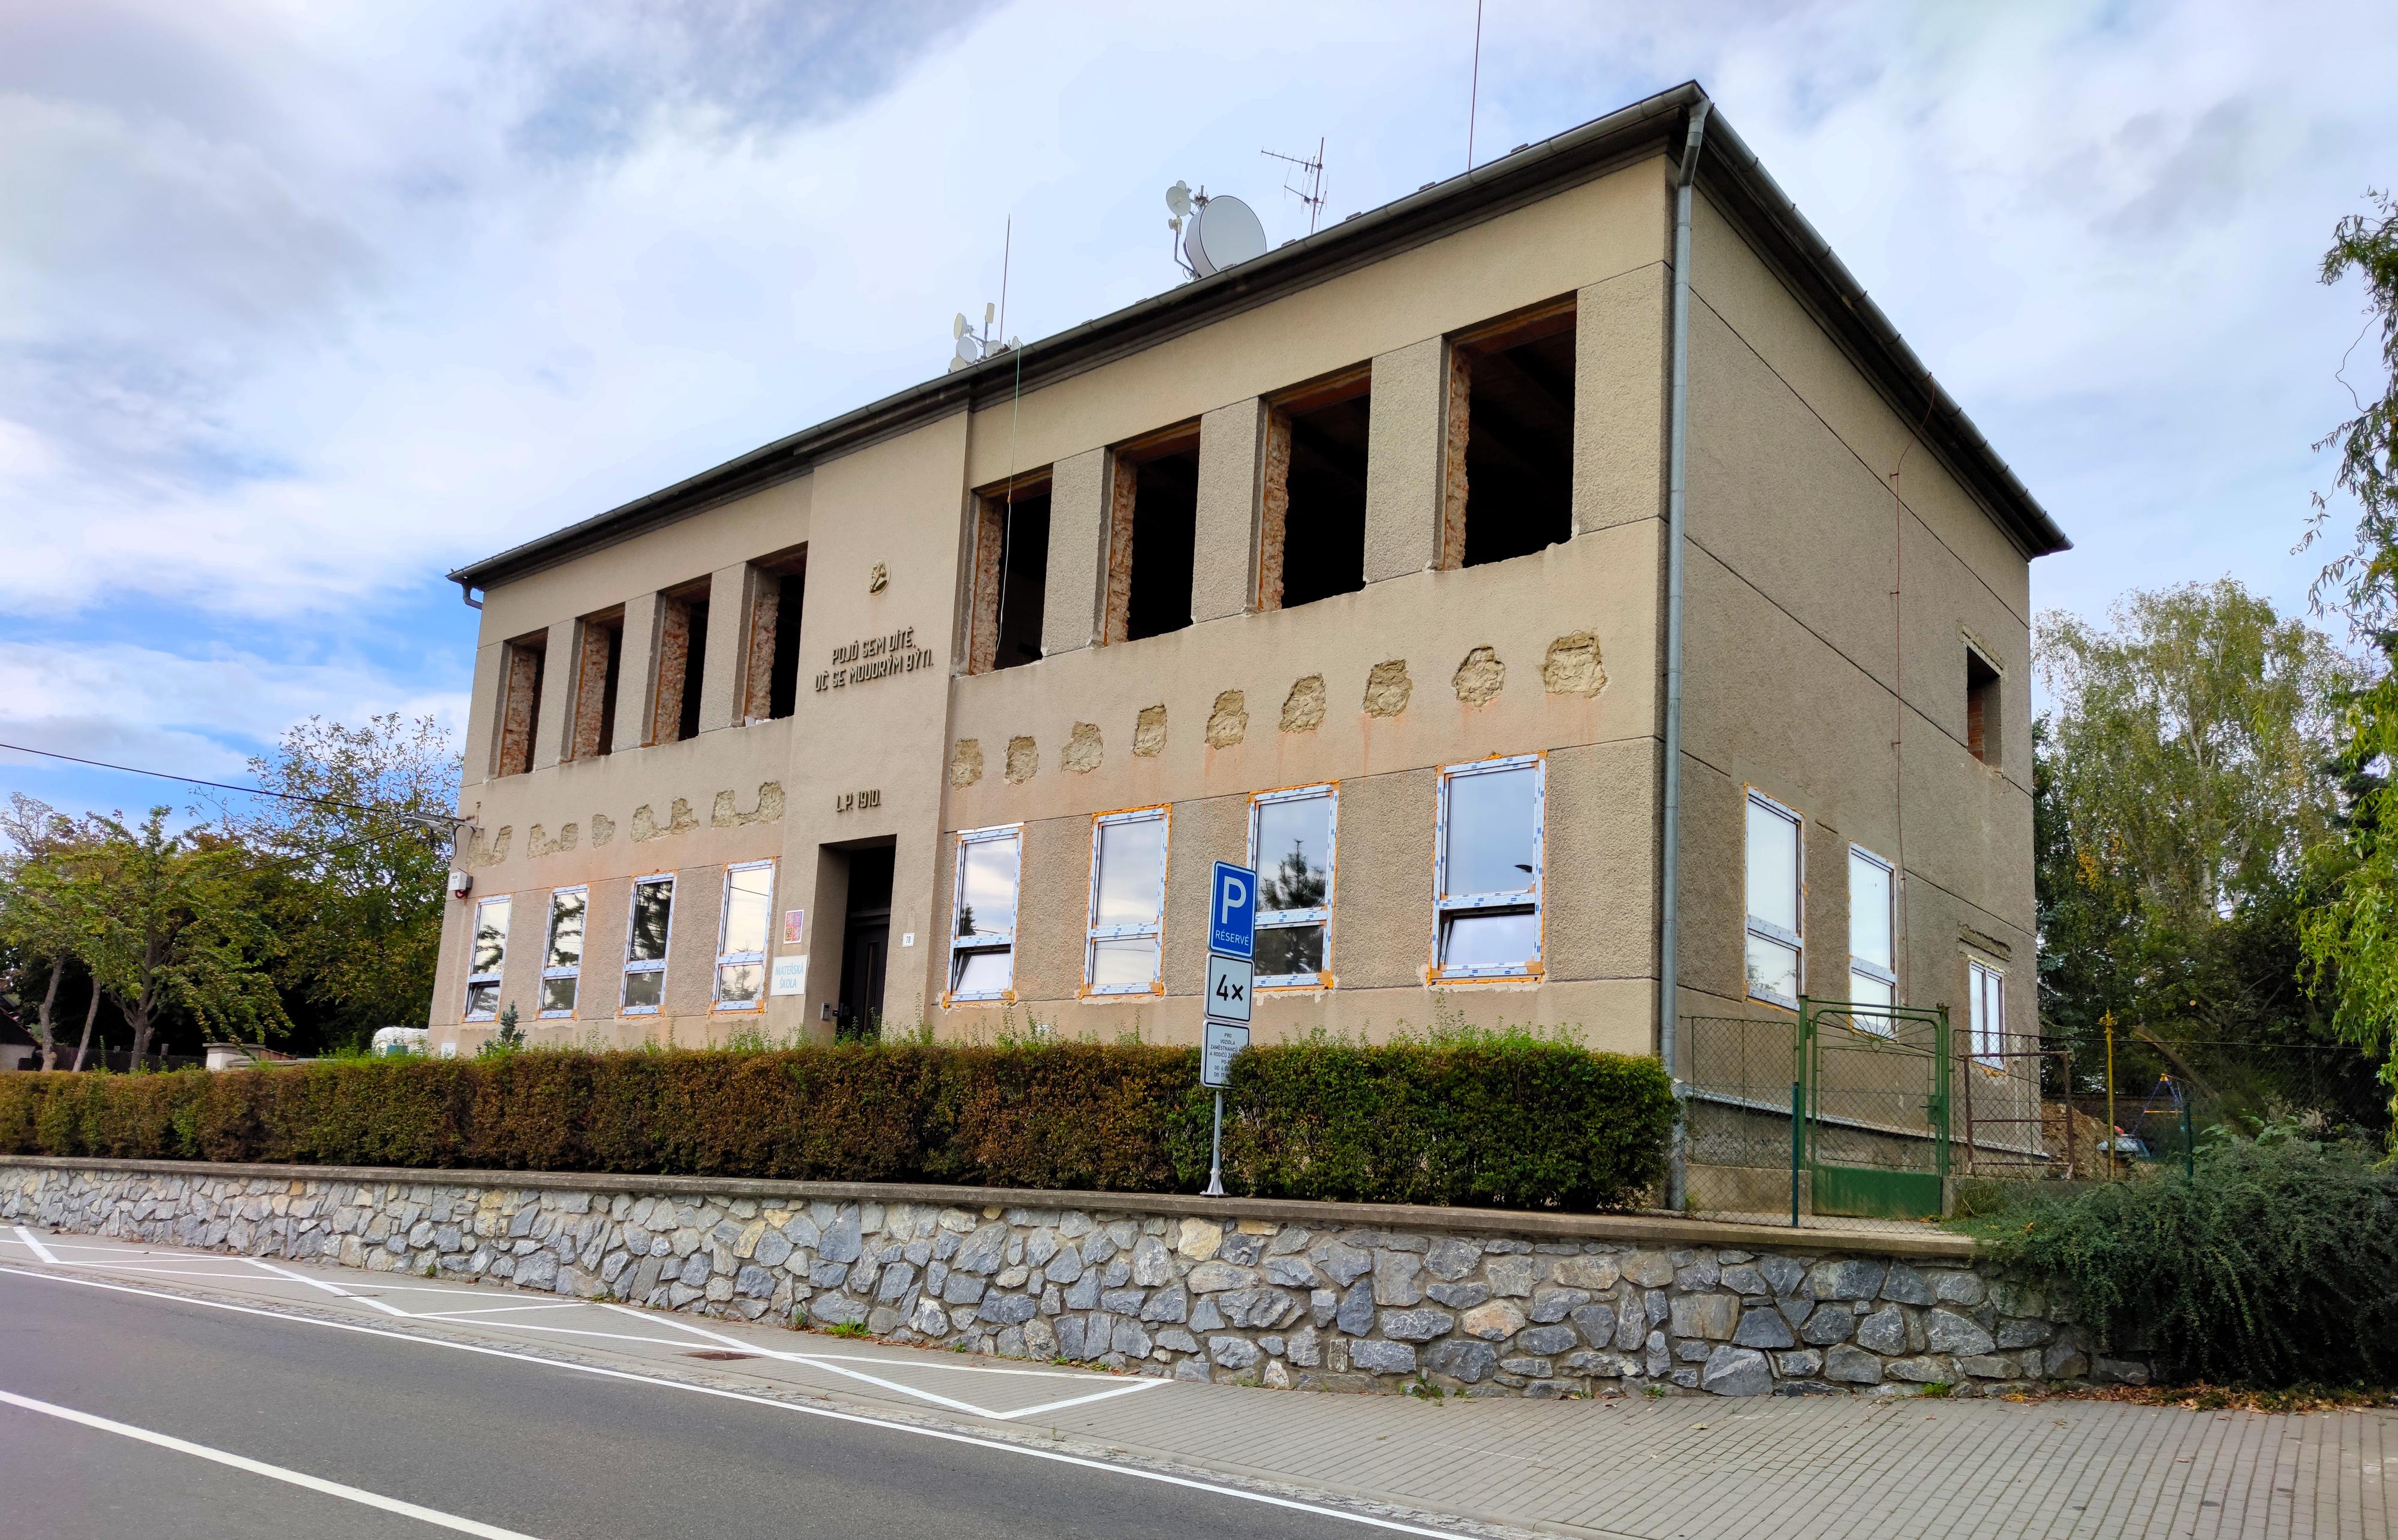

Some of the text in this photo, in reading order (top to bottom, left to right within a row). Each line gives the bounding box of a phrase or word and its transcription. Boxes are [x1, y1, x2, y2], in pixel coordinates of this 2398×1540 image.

[832, 668, 846, 688] SE
[1221, 875, 1247, 924] P
[1215, 929, 1249, 946] RÉSERVÉ
[775, 962, 804, 977] MATEŘSKÁ
[779, 976, 797, 989] ŠKOLA
